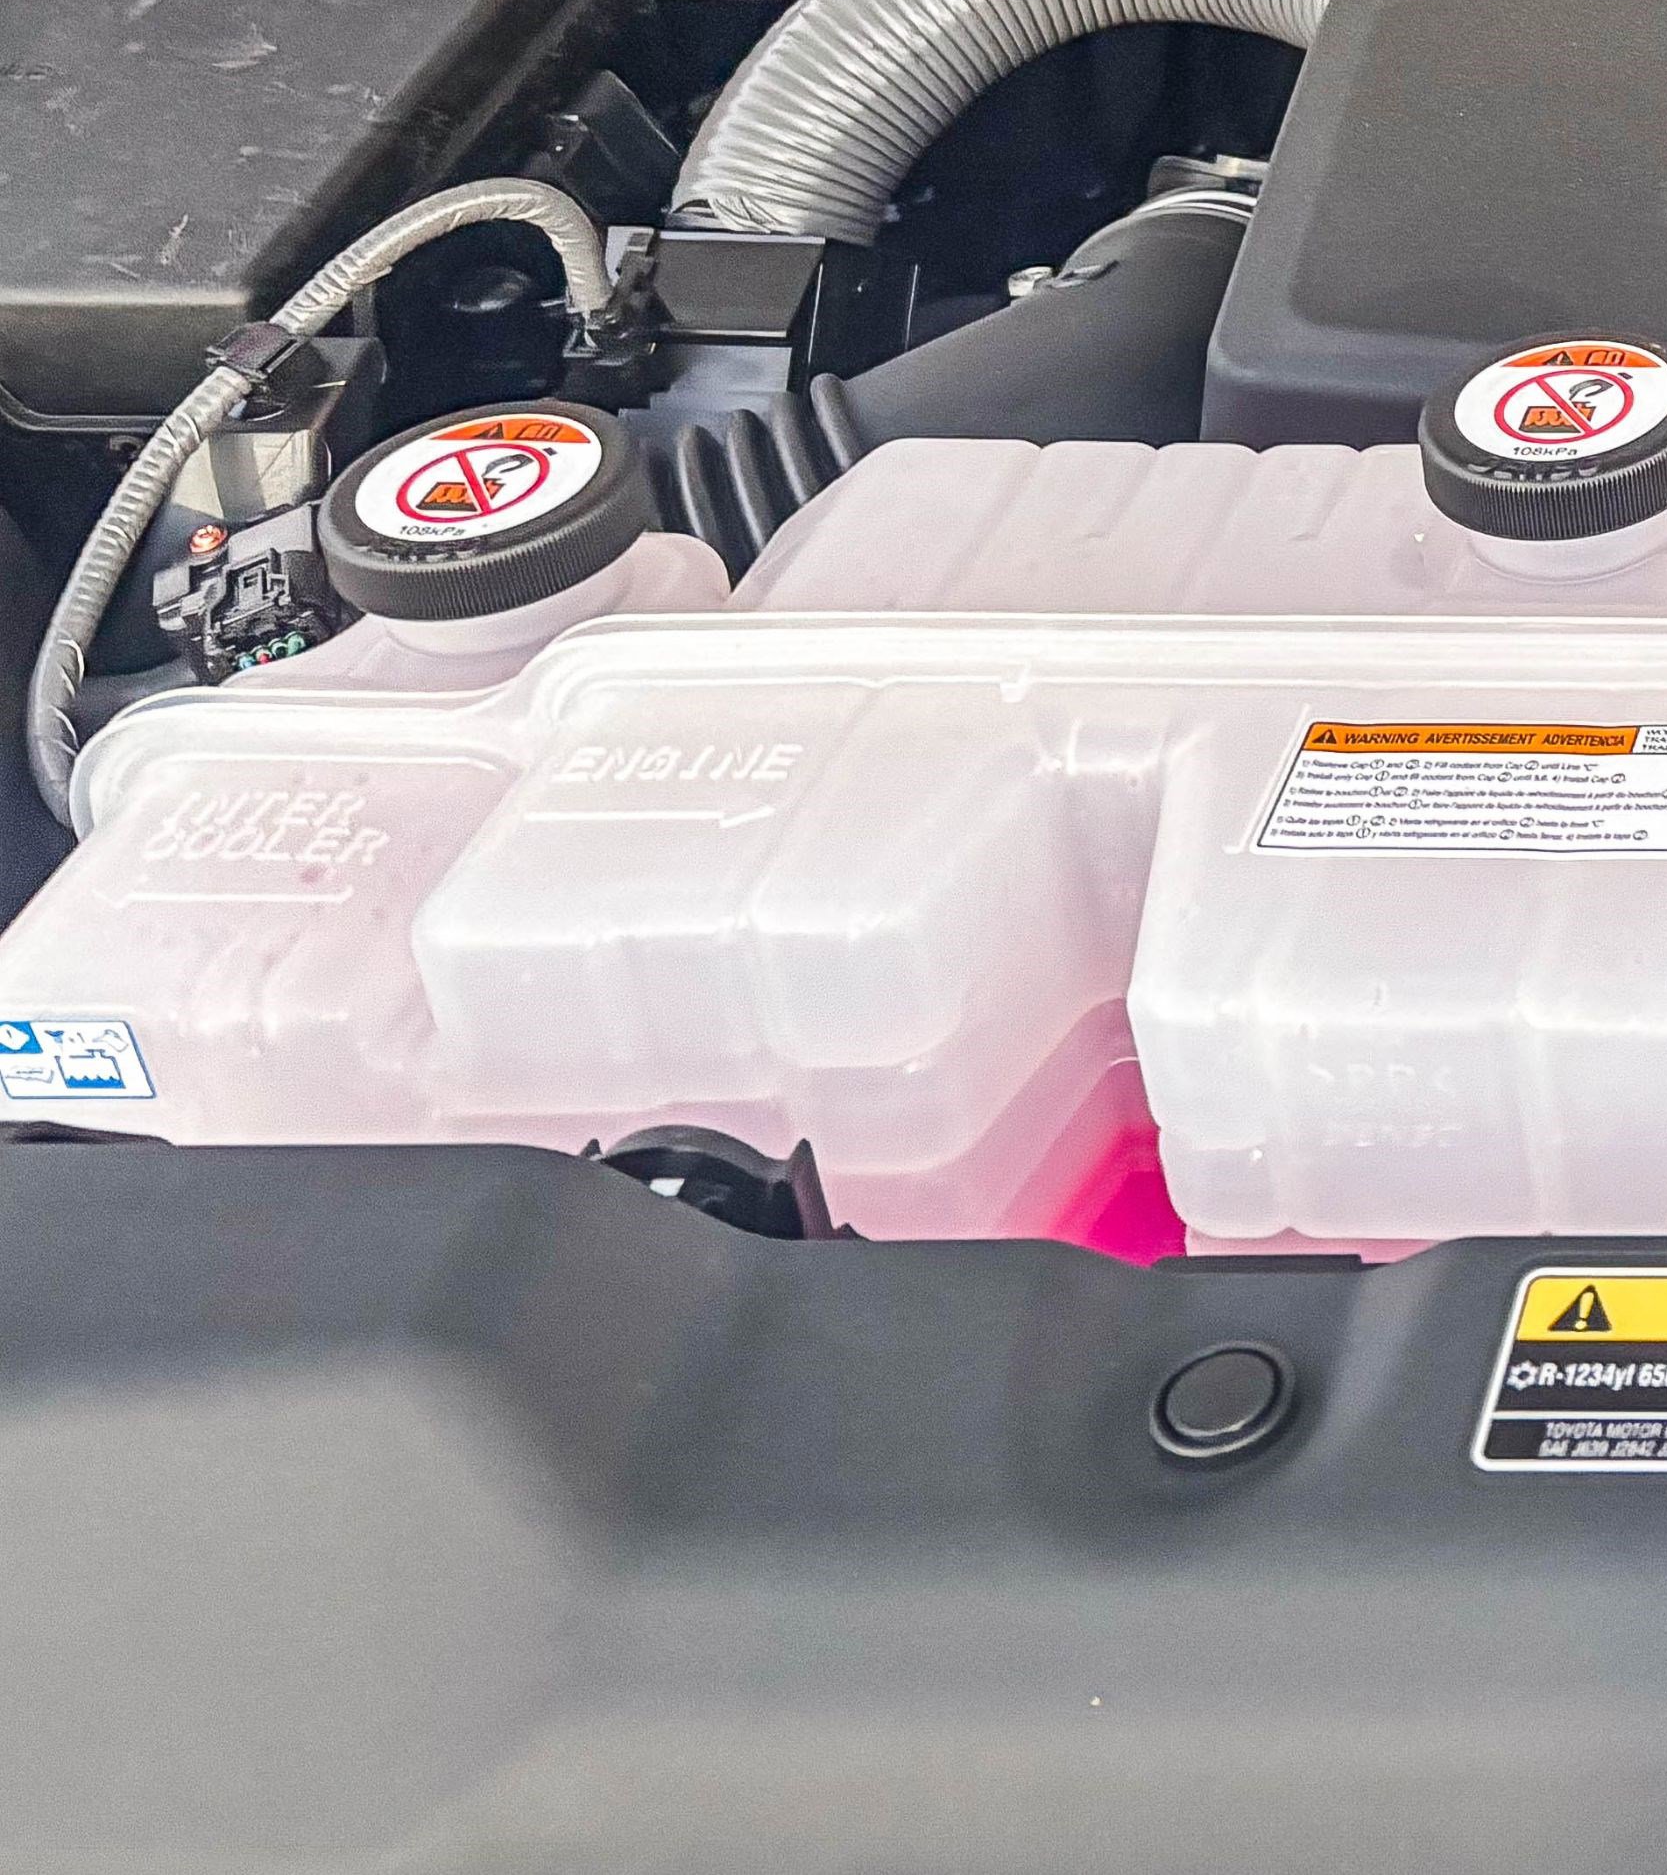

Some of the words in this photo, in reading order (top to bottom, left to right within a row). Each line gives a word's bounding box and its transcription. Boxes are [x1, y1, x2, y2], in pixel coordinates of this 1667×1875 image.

[1512, 445, 1579, 457] 108kPa
[1343, 732, 1420, 746] WARNING
[1424, 732, 1537, 747] AVERTISSEMENT
[1541, 733, 1627, 748] ADVERTENCIA
[552, 744, 802, 783] ENGINE
[164, 790, 368, 827] INTER
[142, 826, 391, 865] COOLER
[1539, 1362, 1636, 1392] R-1234yf
[1545, 1422, 1605, 1440] TOYOTA
[1606, 1423, 1664, 1440] MOTOR
